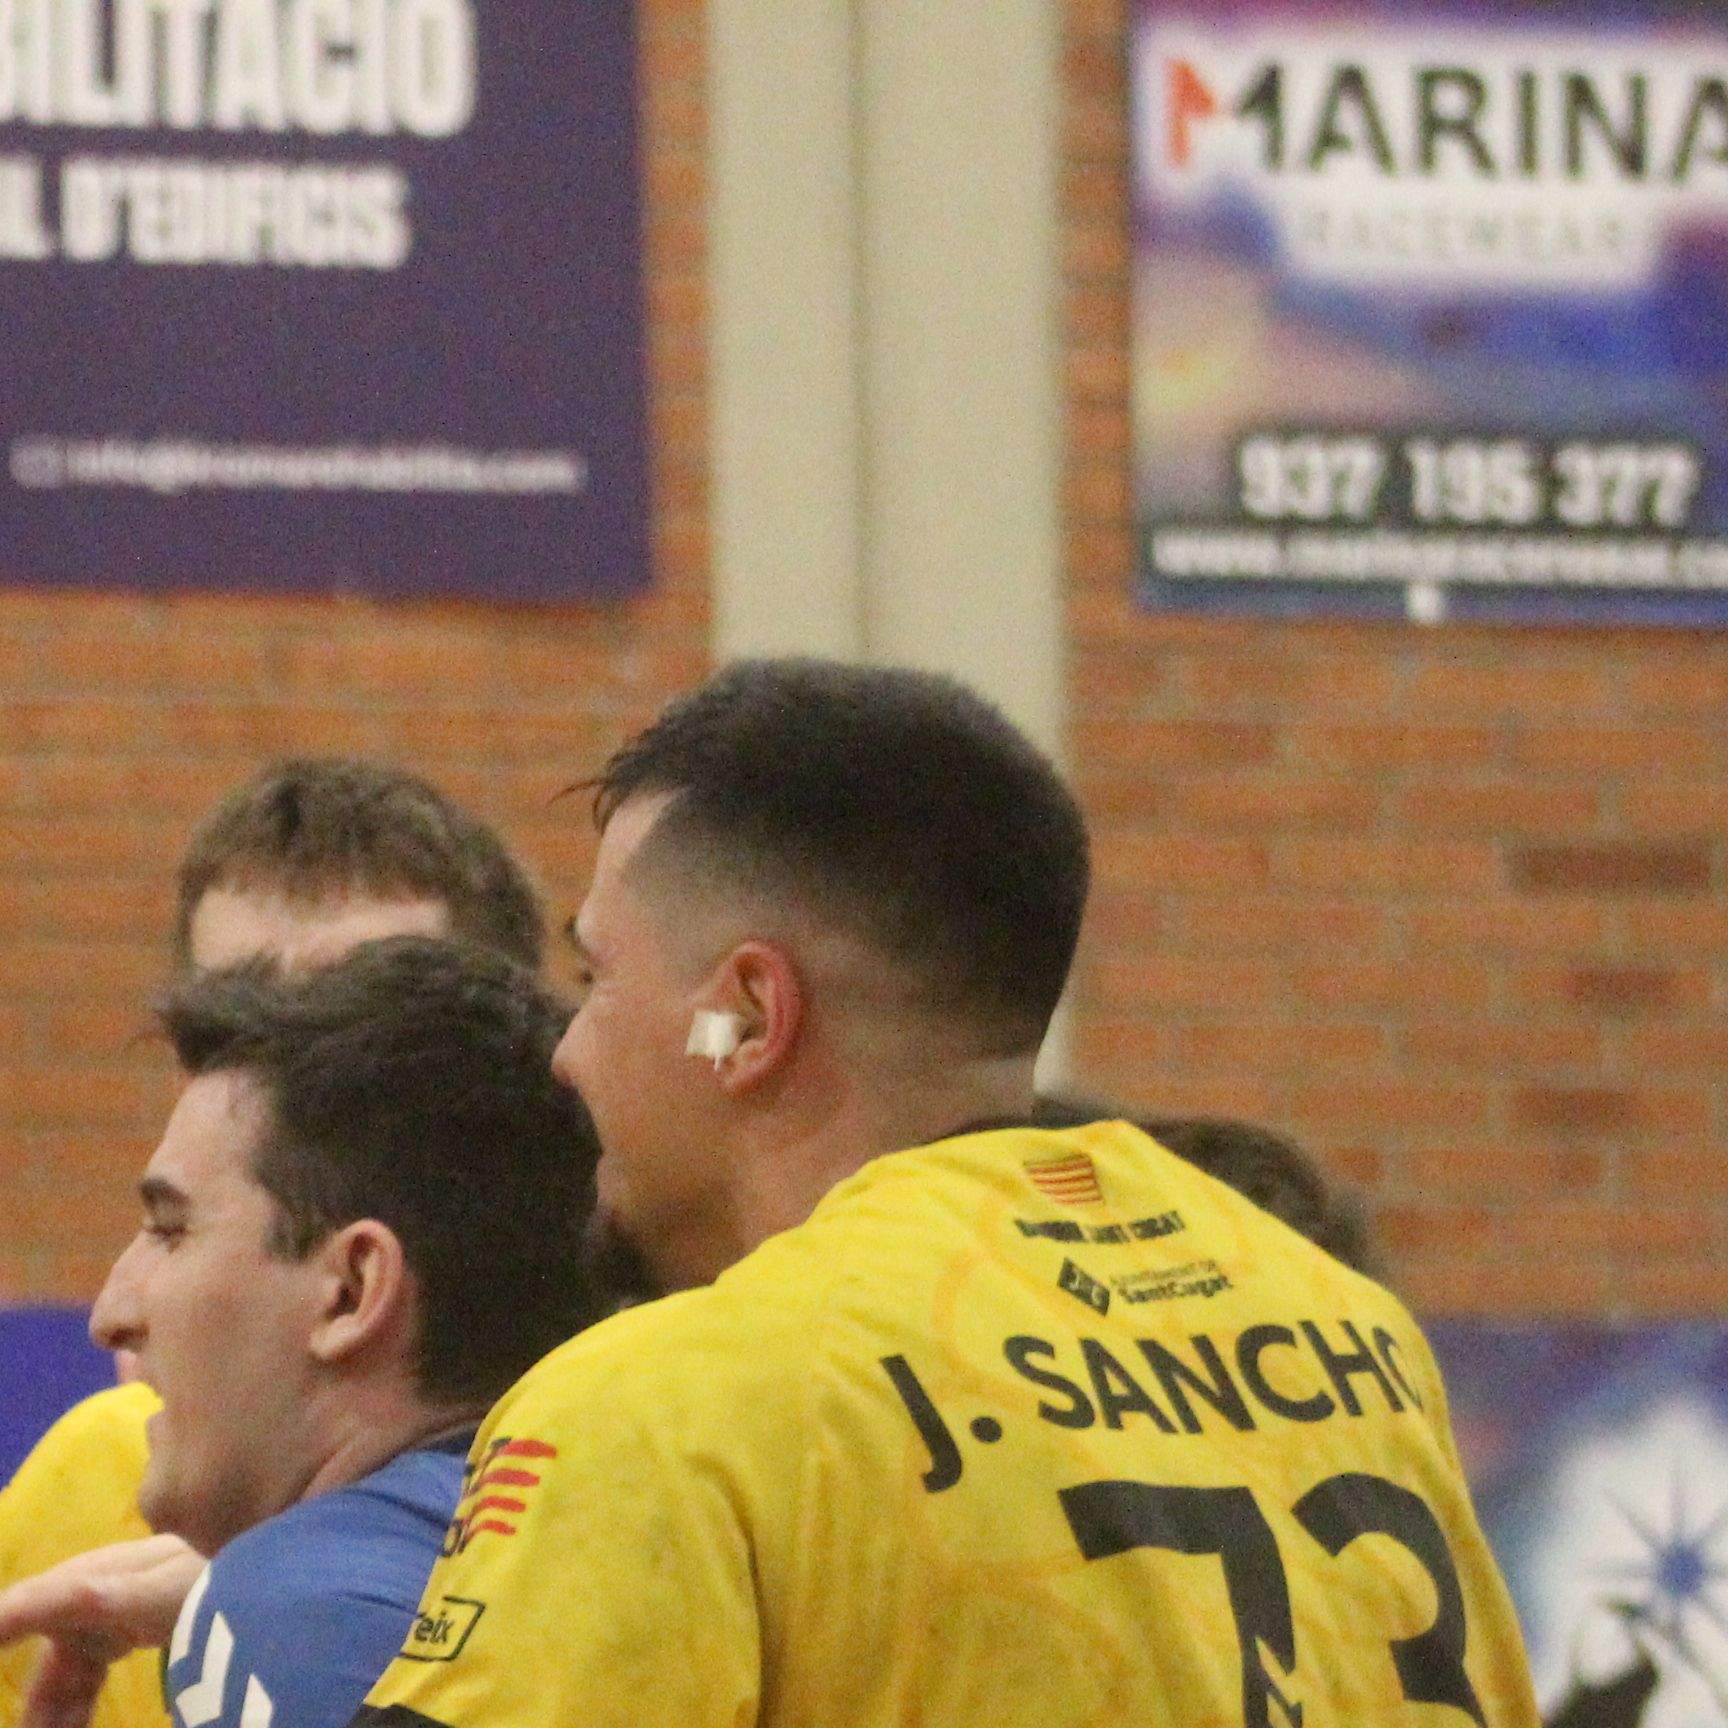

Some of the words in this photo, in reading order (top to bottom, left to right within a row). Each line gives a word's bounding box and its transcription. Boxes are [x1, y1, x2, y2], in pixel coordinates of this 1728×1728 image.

[1160, 55, 1728, 186] MARINA
[59, 154, 414, 271] D'EDIFICIS
[1237, 434, 1389, 520] 937
[1400, 436, 1544, 525] 195
[1550, 440, 1704, 528] 377
[880, 1353, 1003, 1494] J.
